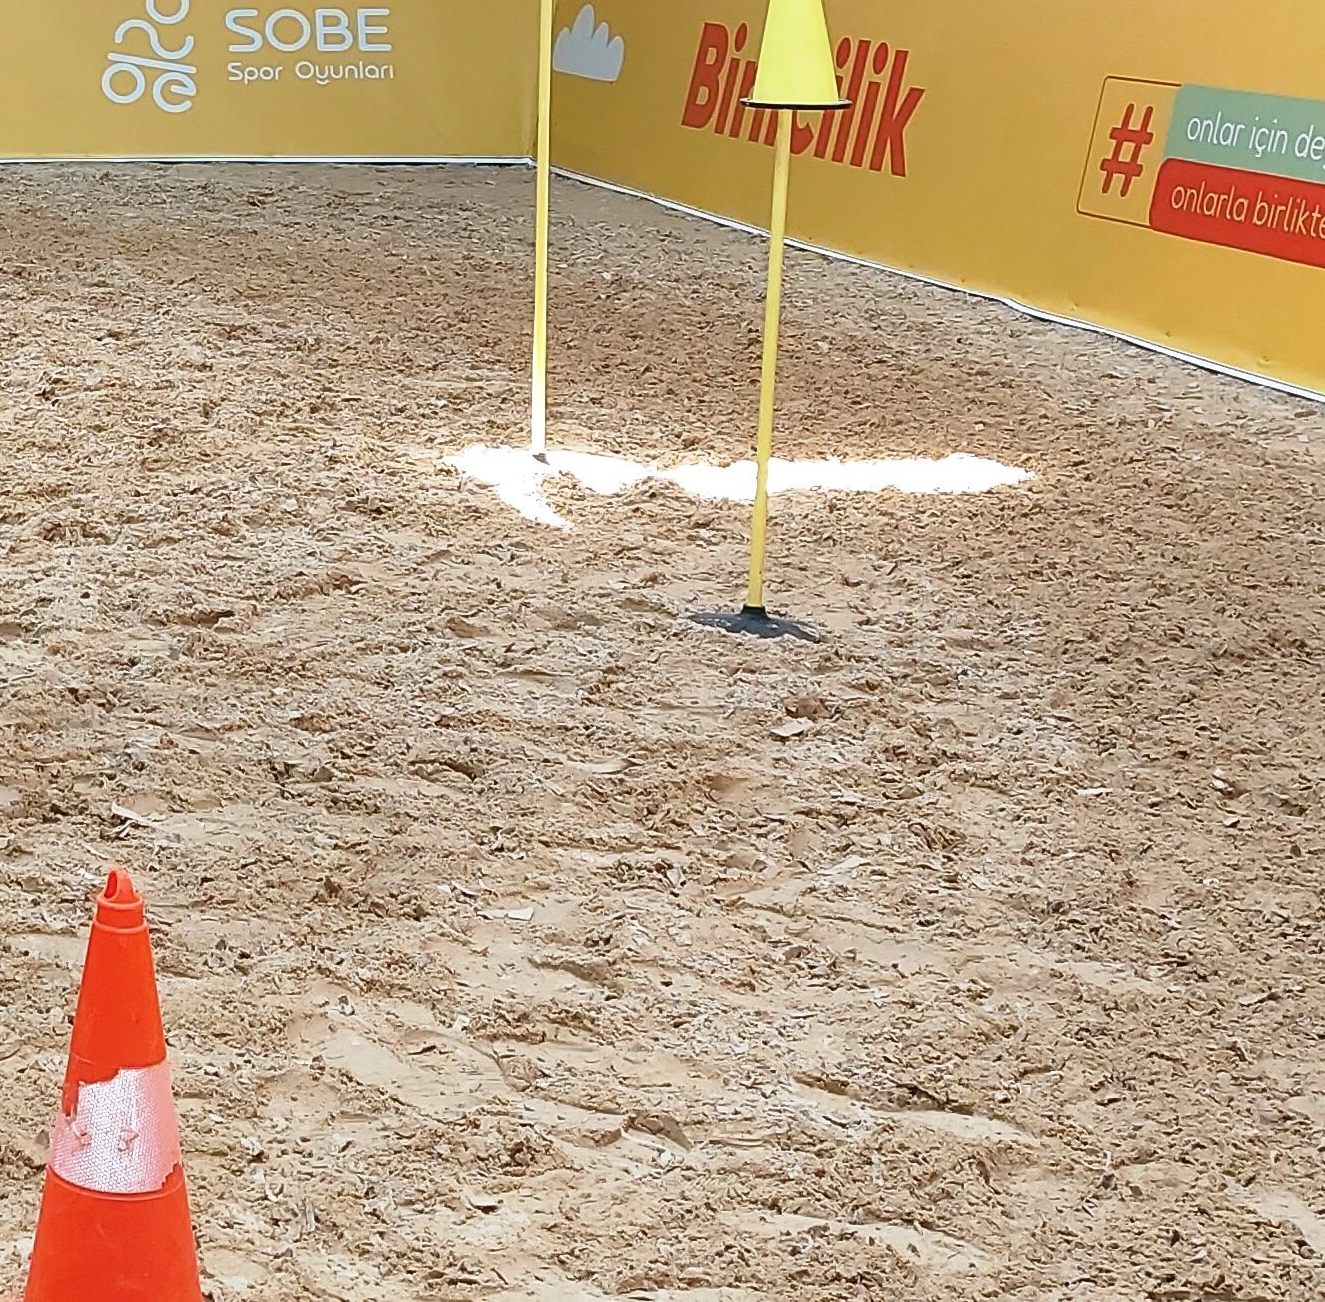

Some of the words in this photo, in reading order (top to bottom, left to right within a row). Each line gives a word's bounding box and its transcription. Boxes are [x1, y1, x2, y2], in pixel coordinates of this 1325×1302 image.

[224, 7, 393, 53] SOBE
[227, 60, 283, 85] Spor
[294, 59, 395, 86] Oyunları
[1186, 111, 1246, 147] onlar
[1248, 116, 1288, 158] için
[1170, 181, 1250, 223] onlarla
